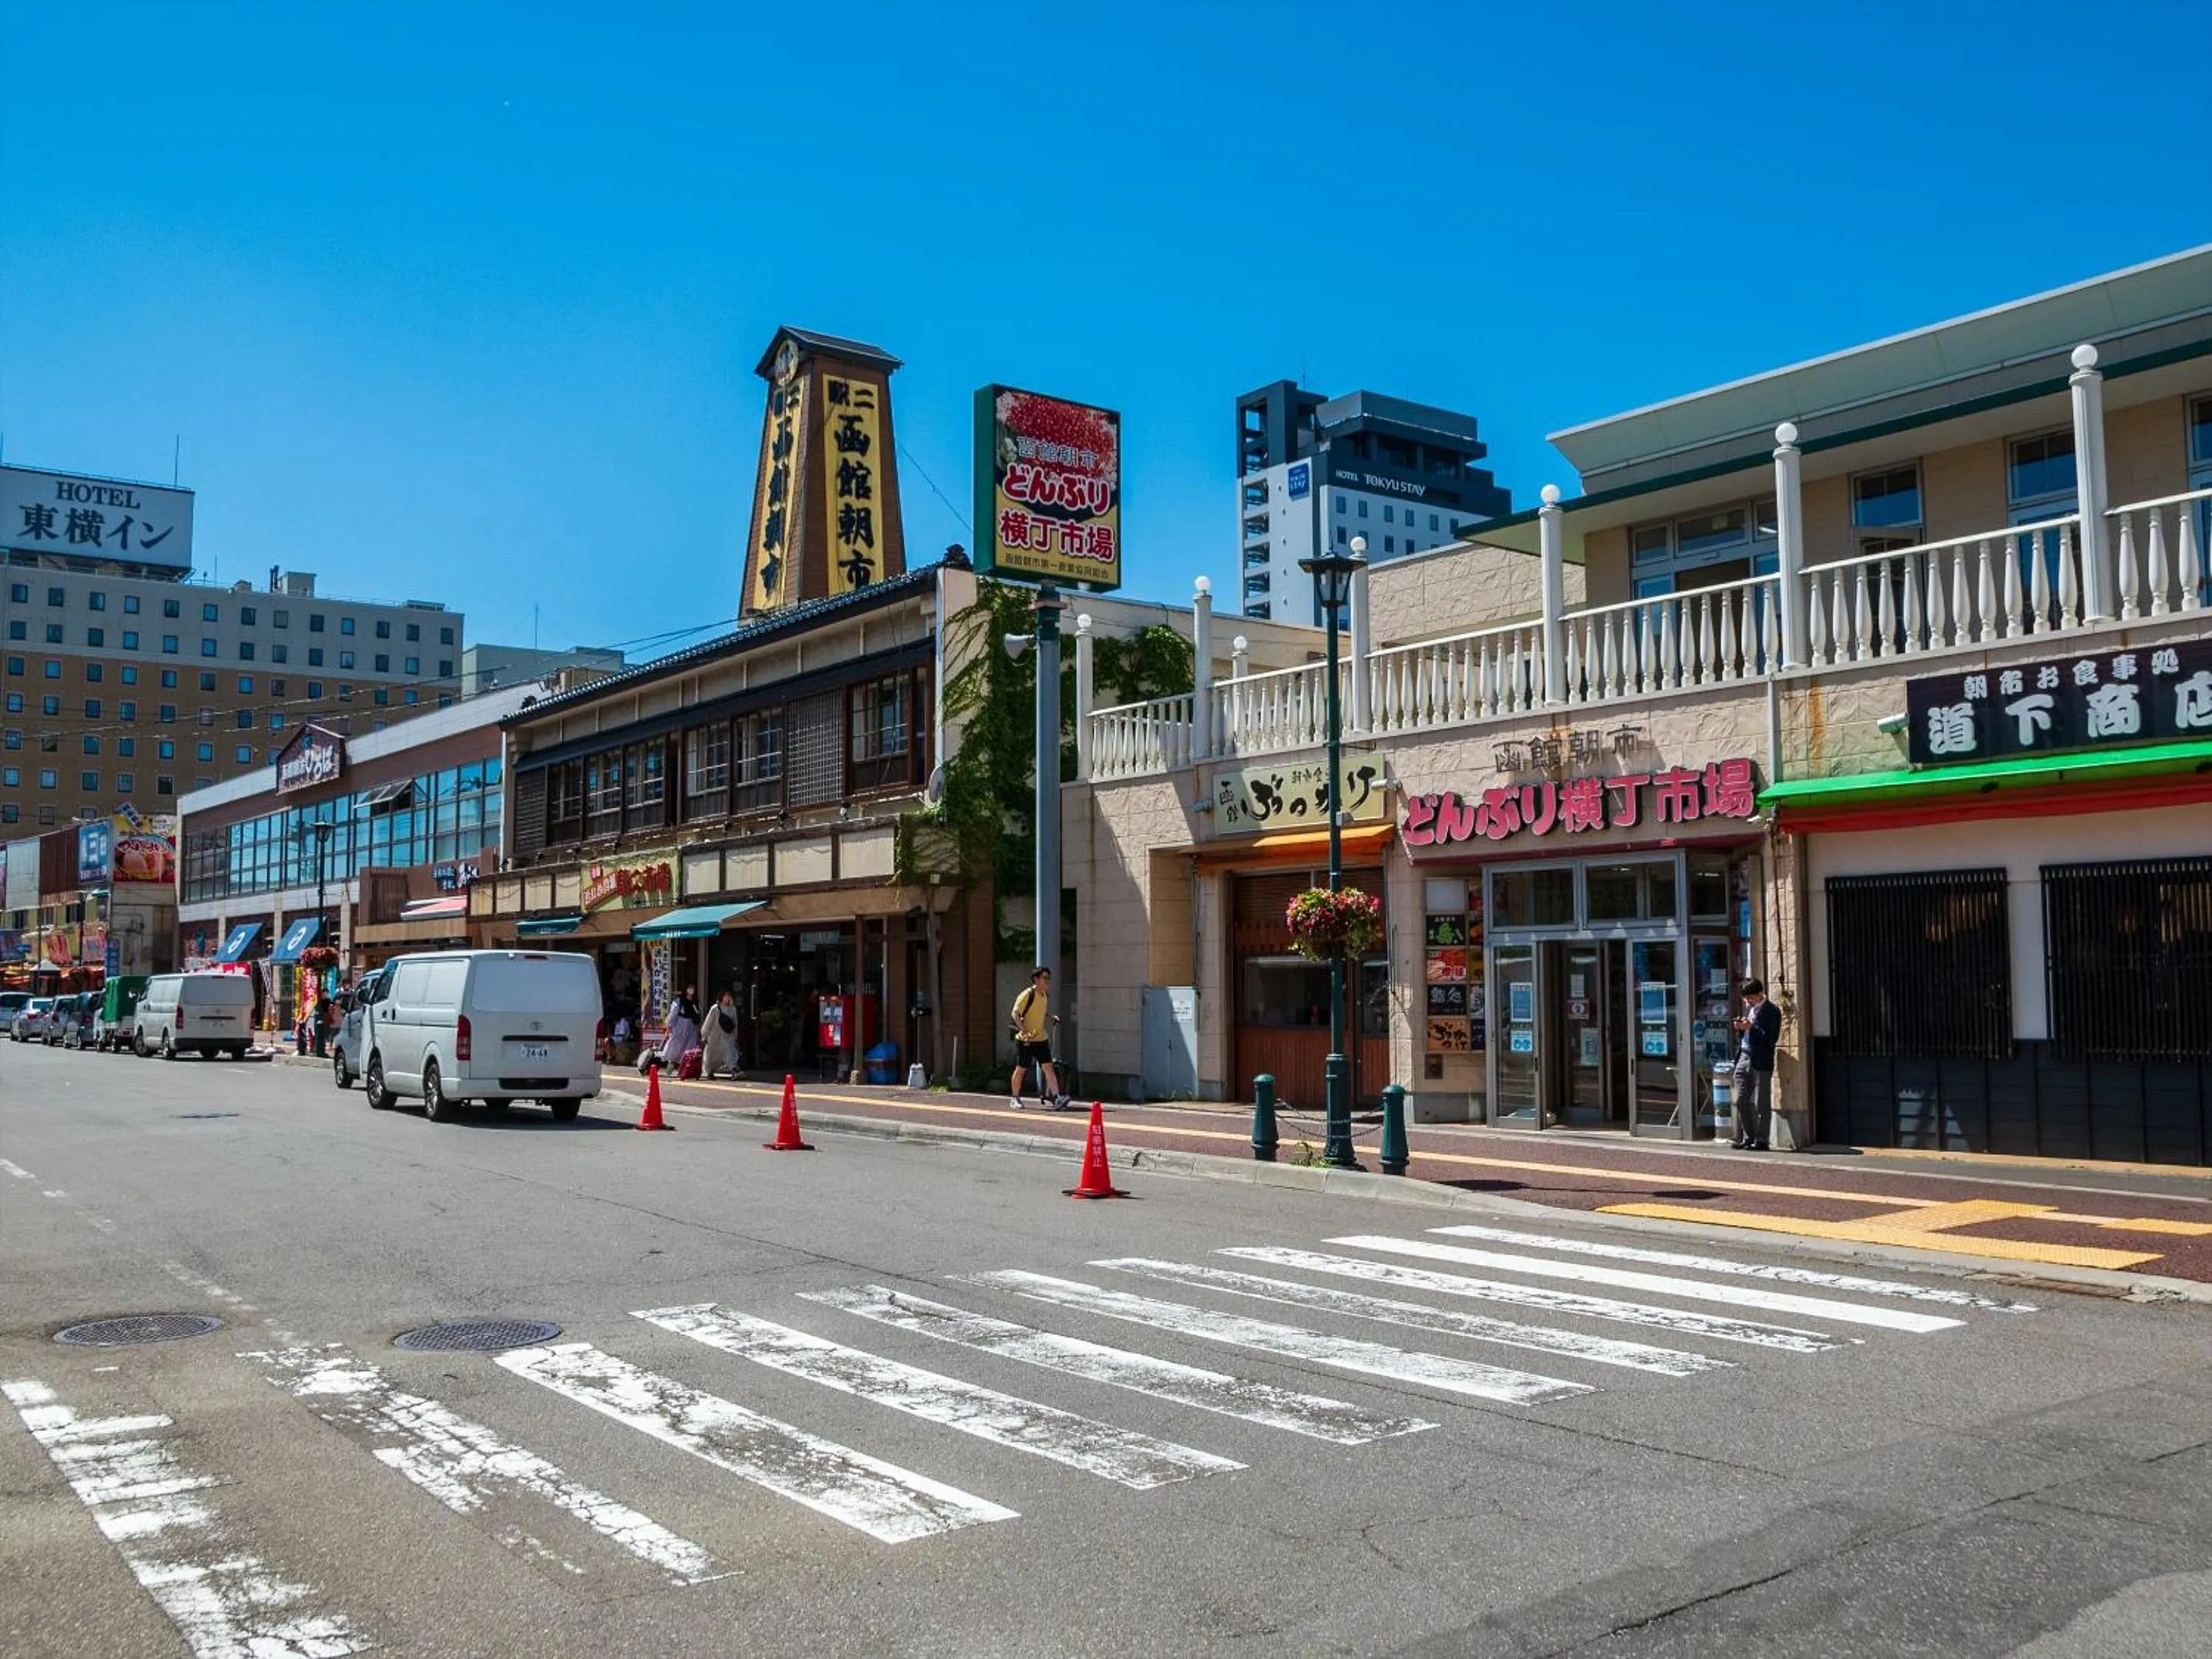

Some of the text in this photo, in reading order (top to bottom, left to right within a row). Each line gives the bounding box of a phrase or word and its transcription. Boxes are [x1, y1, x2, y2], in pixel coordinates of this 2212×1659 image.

[56, 481, 141, 509] HOTEL
[1003, 462, 1111, 515] どんぶり
[1335, 469, 1359, 482] HOTEL
[17, 502, 175, 550] 東横イン
[1001, 508, 1116, 563] 横丁市場
[1963, 647, 2180, 700] 朝市お食事処
[1927, 670, 2212, 755] 道下商店
[1492, 724, 1644, 773] 函館朝市
[1404, 757, 1757, 846] どんぶり横丁市場
